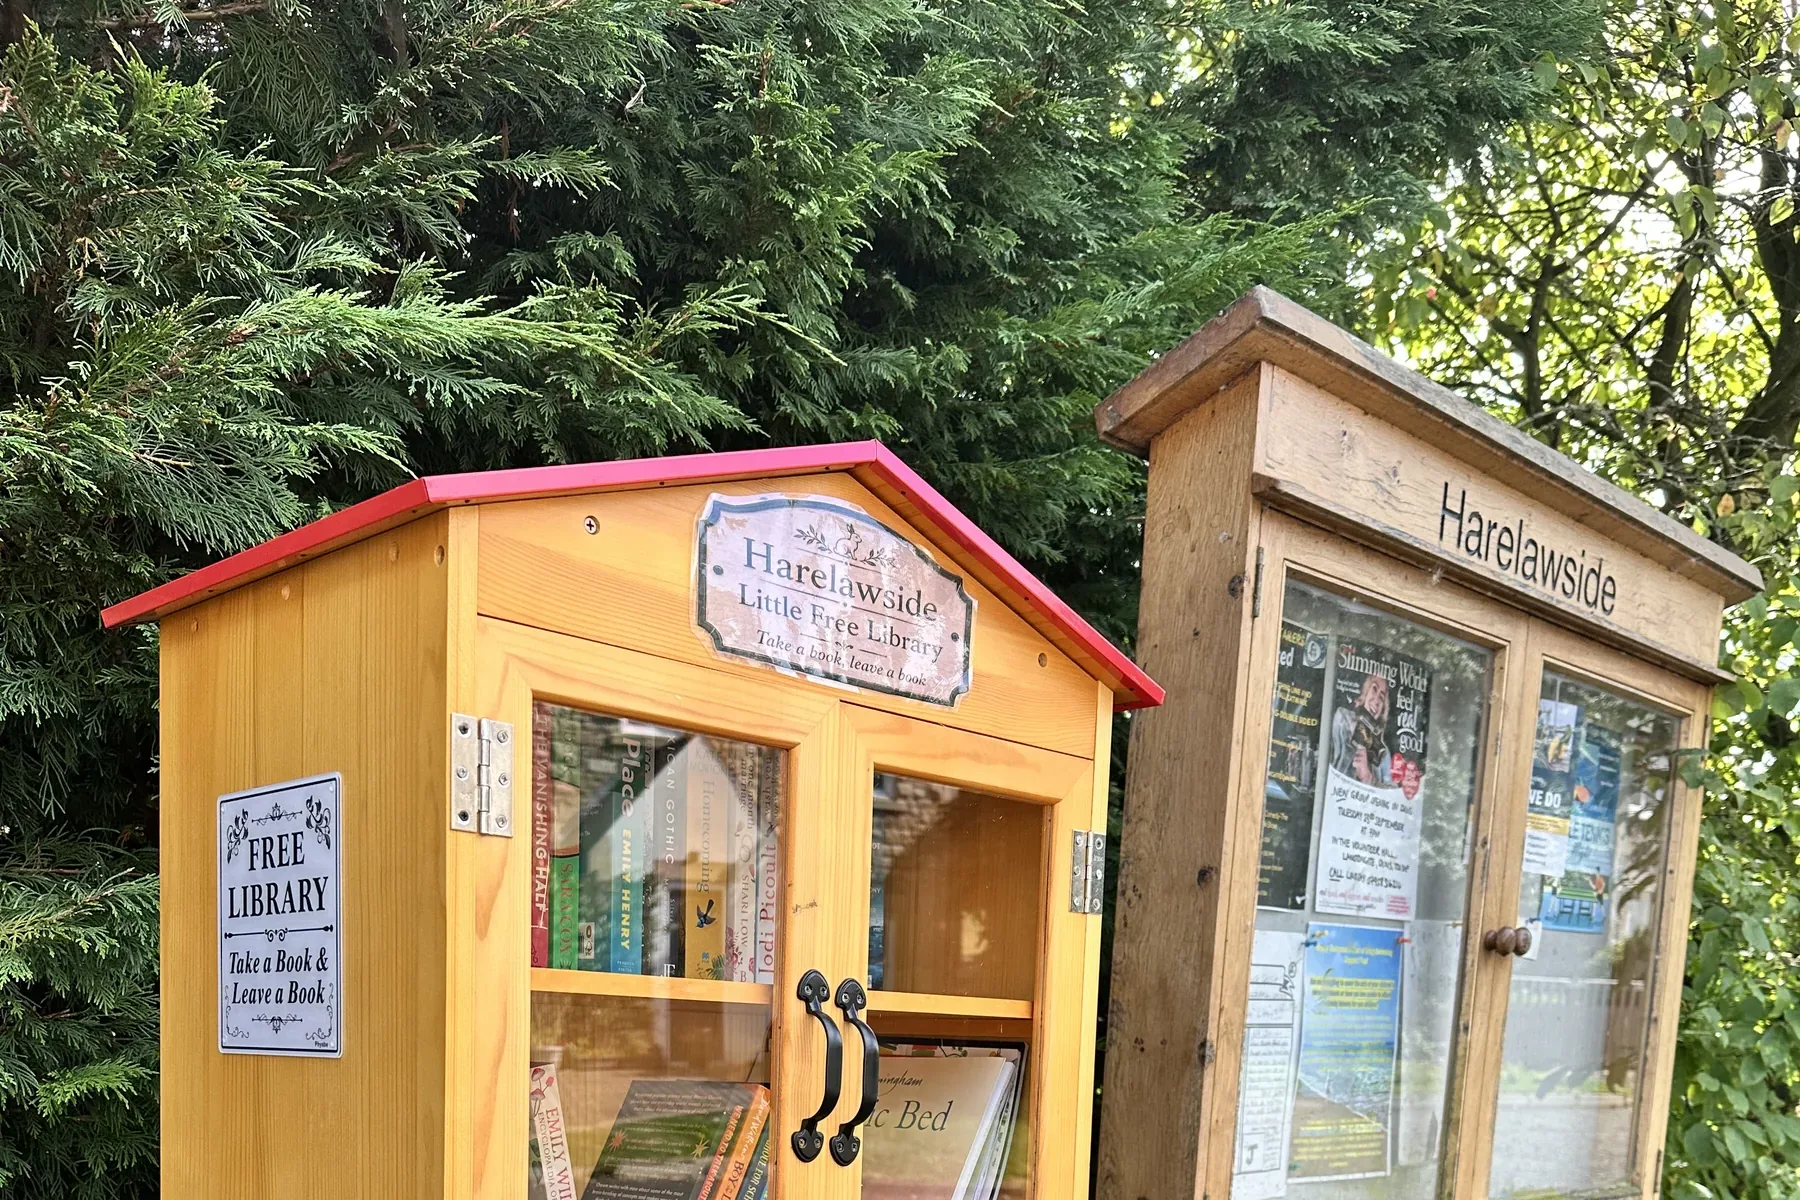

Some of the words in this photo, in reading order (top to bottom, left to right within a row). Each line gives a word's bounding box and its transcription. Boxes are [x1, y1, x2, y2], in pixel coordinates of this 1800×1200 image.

[1440, 481, 1616, 616] Harelawside
[743, 536, 938, 622] Harelawside
[738, 583, 803, 621] Little
[810, 603, 859, 637] Free
[866, 619, 944, 663] Library
[756, 629, 792, 652] Take
[796, 644, 805, 656] a
[810, 643, 846, 668] book,
[850, 655, 883, 677] leave
[886, 667, 895, 679] a
[898, 665, 927, 687] book
[1338, 644, 1398, 688] Slimming
[1399, 660, 1428, 692] World
[1396, 687, 1414, 711] feel
[1397, 705, 1418, 731] real
[536, 716, 548, 752] THE
[1399, 731, 1424, 753] good
[622, 737, 641, 818] Place
[765, 756, 773, 781] you
[535, 757, 549, 859] VANISHING
[747, 789, 755, 829] month
[762, 787, 772, 816] wish
[1544, 791, 1561, 808] DO
[248, 830, 305, 872] FREE
[665, 799, 675, 864] GOTHIC
[697, 780, 715, 894] Homecoming
[622, 829, 632, 883] EMILY
[228, 876, 329, 919] LIBRARY
[535, 867, 547, 912] HALF
[560, 862, 573, 913] SARA
[741, 874, 749, 914] SHARI
[760, 844, 776, 921] Picoult
[560, 915, 573, 957] COX
[620, 889, 631, 951] HENRY
[740, 918, 749, 947] LOW
[229, 951, 260, 975] Take
[263, 957, 272, 972] a
[275, 948, 312, 973] Book
[316, 947, 329, 972] &
[758, 932, 775, 974] Jodi
[232, 982, 272, 1004] Leave
[275, 990, 283, 1004] a
[287, 980, 325, 1004] Book
[724, 1119, 739, 1141] NEED
[732, 1104, 744, 1119] WE
[894, 1099, 954, 1131] Bed
[537, 1111, 555, 1189] ENCYCLOPAEDIA
[545, 1105, 567, 1163] EMILY
[719, 1141, 729, 1154] TO
[708, 1154, 724, 1177] TALK
[727, 1160, 744, 1188] BOY
[754, 1167, 764, 1186] FOR
